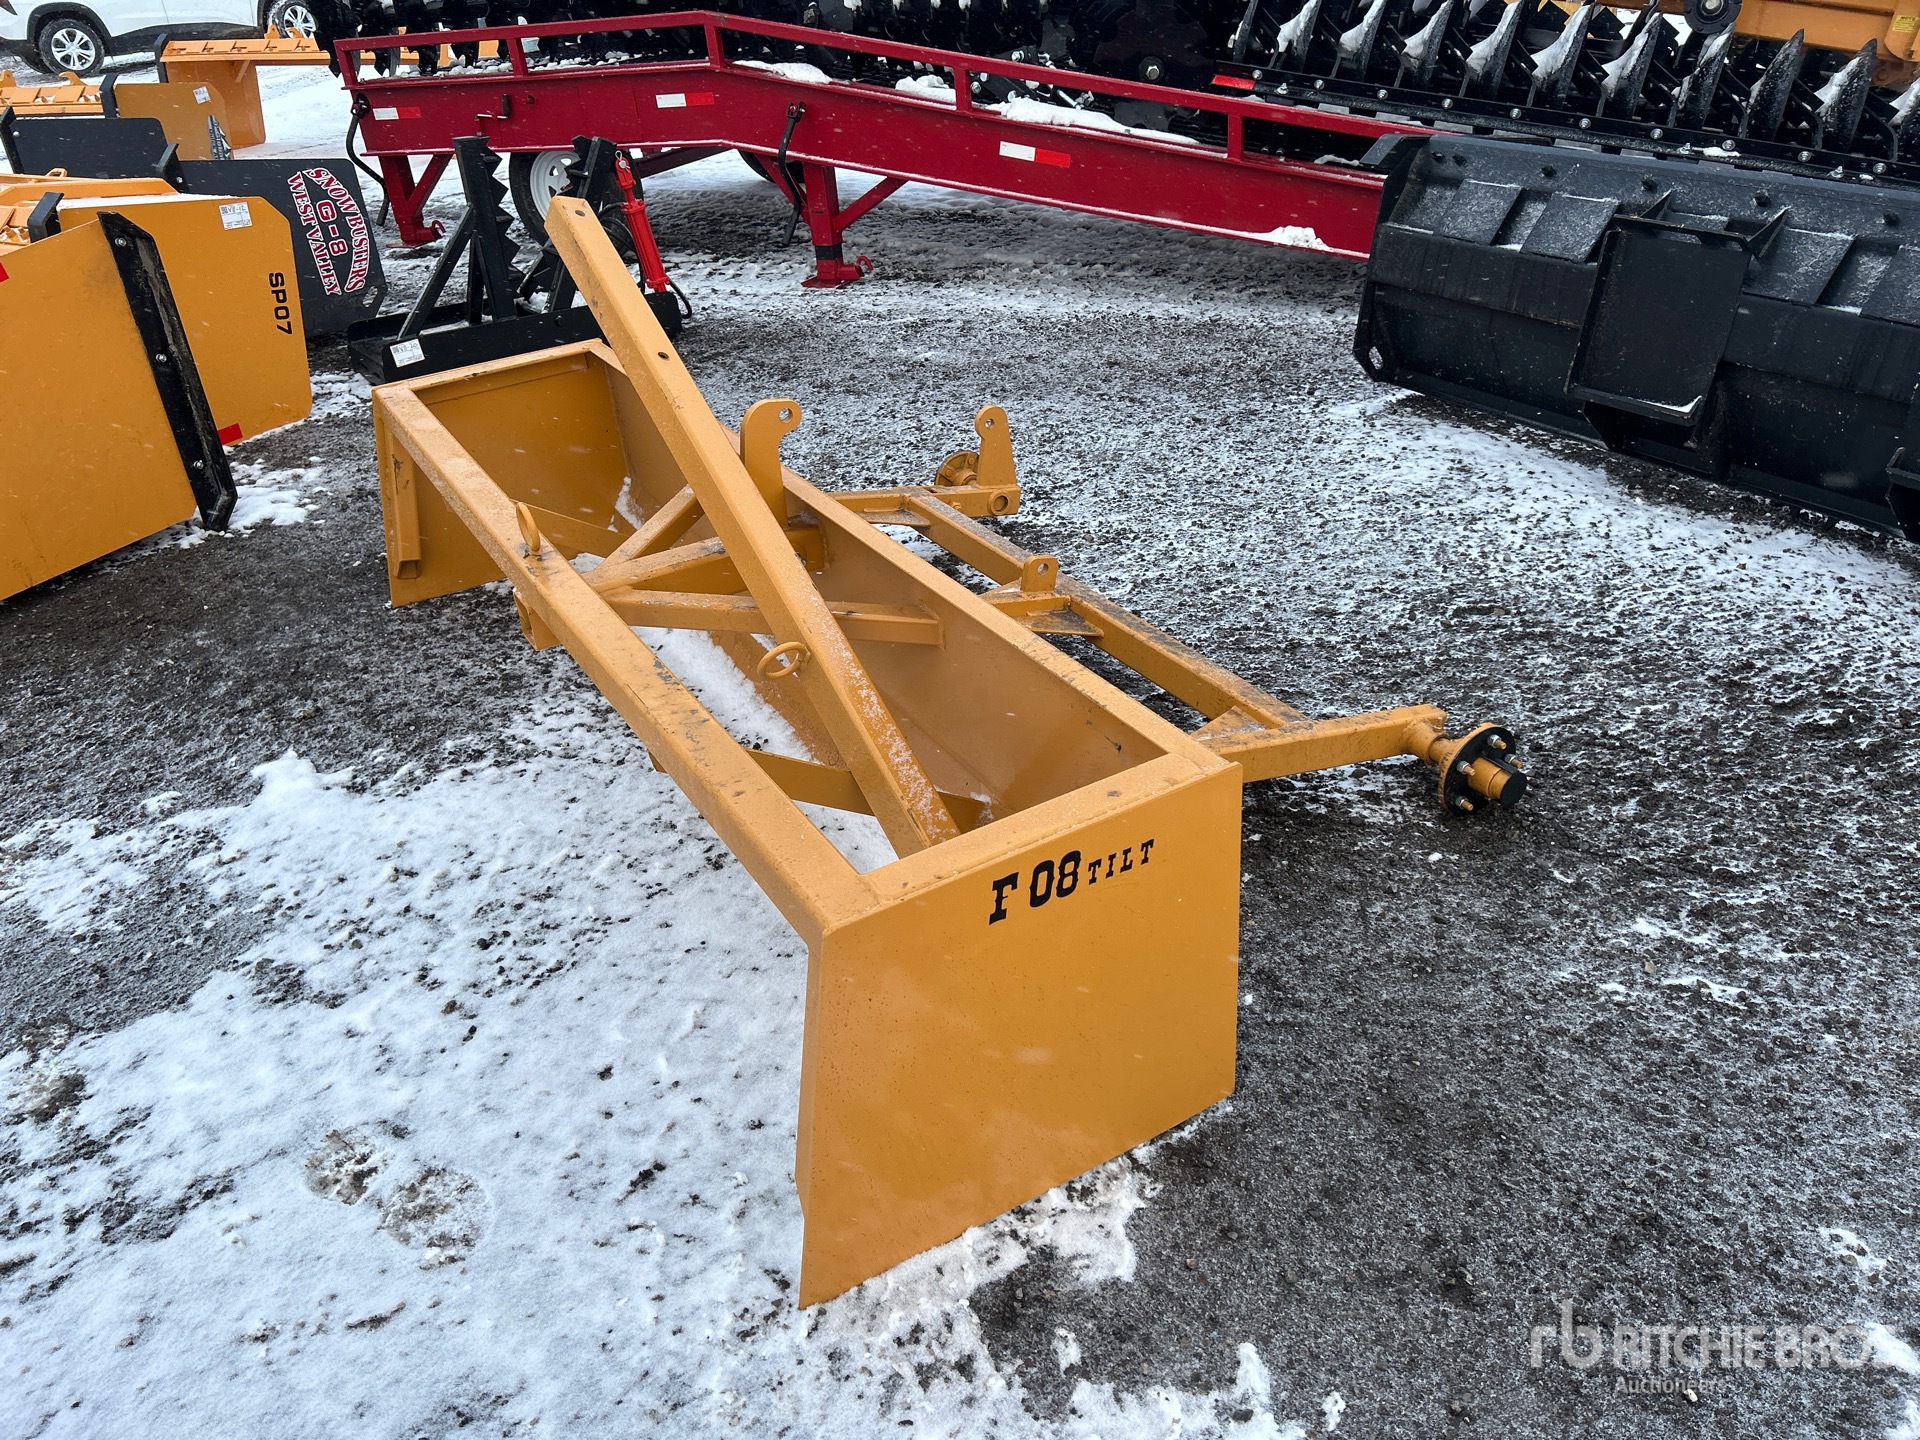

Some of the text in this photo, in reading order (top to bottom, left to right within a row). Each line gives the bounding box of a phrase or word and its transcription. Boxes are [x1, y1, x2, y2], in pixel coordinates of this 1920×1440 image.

[287, 171, 341, 295] WEST VALLEY
[303, 167, 370, 292] SNOW BUSTERS
[316, 200, 348, 256] G-8
[268, 272, 293, 335] SP07
[1088, 838, 1154, 885] TILT
